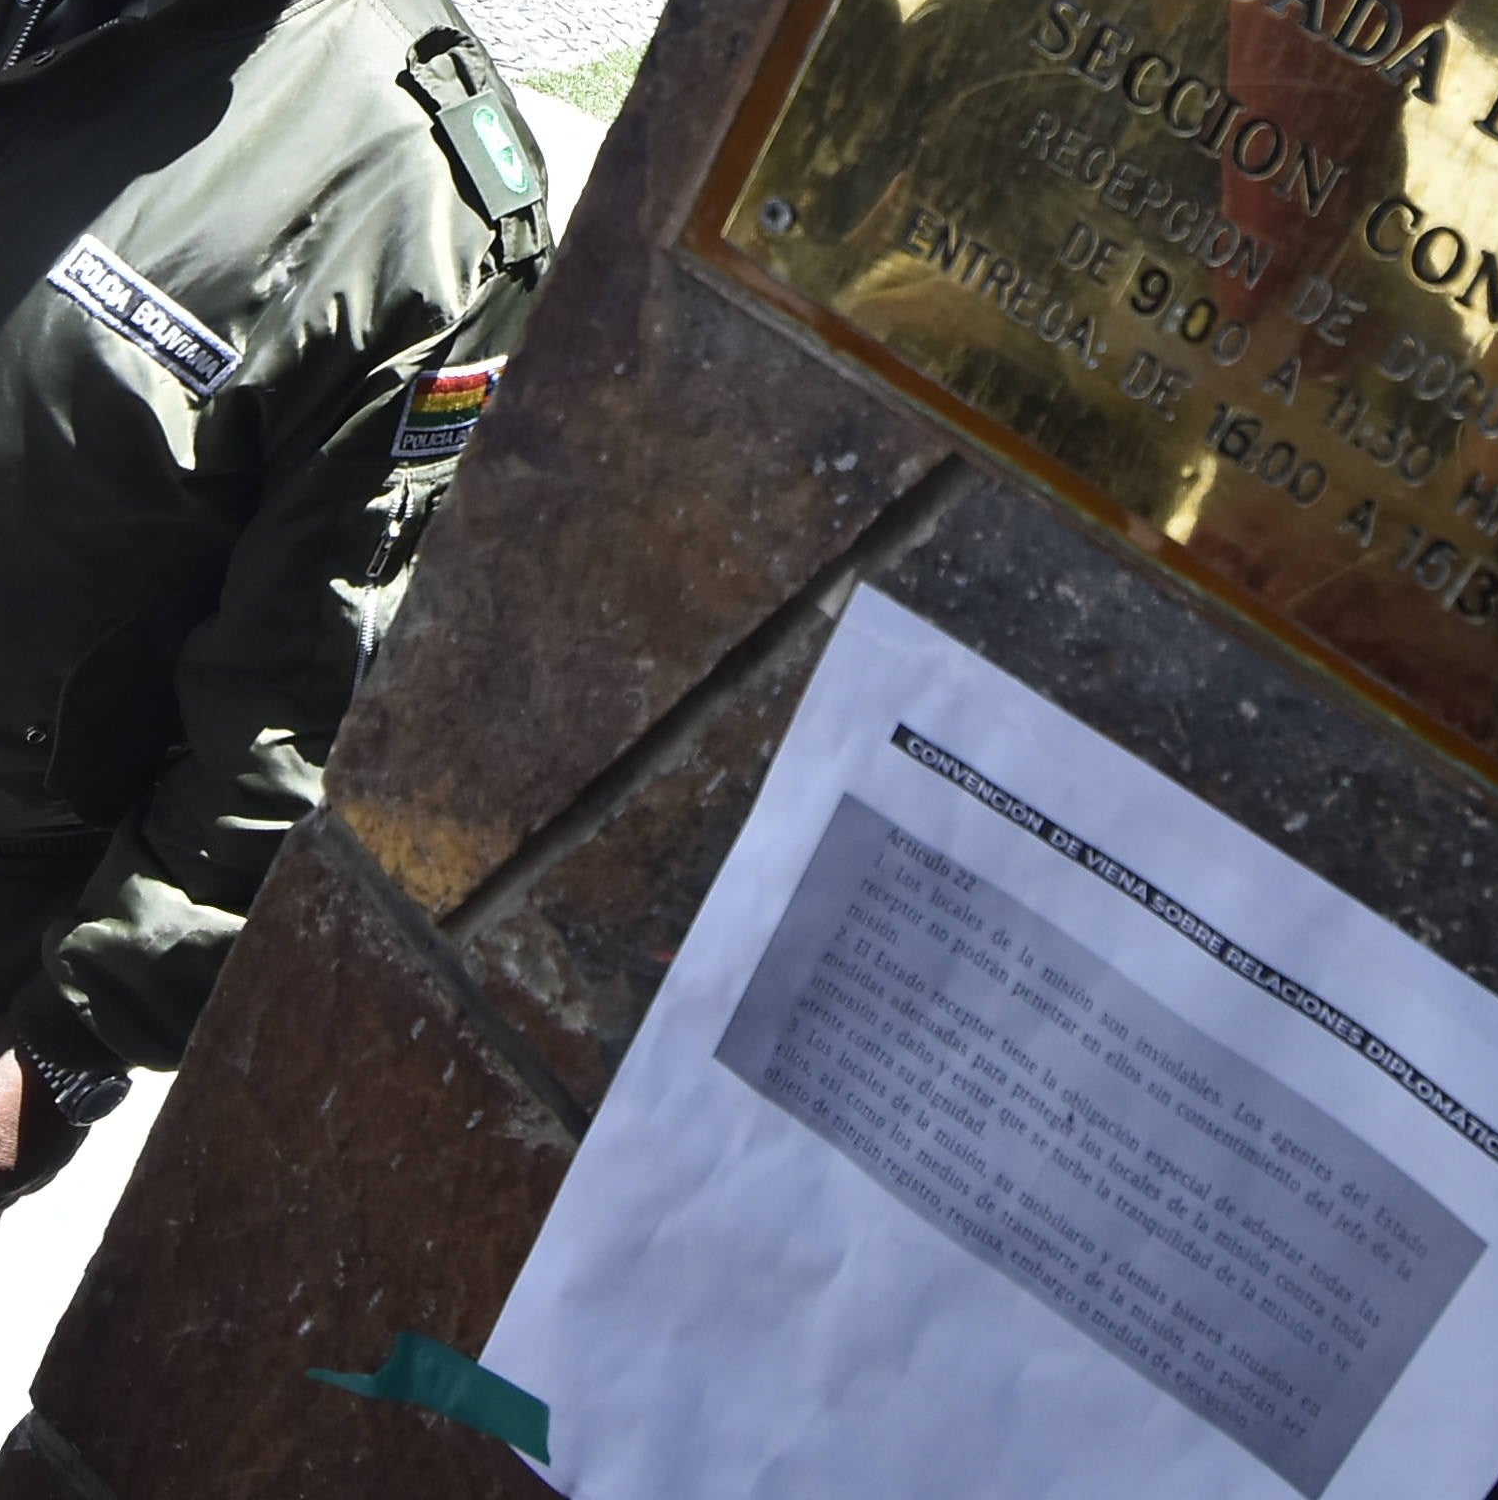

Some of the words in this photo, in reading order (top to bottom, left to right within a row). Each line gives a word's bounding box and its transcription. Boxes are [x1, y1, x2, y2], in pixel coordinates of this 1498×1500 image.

[1020, 109, 1274, 290] RECEPCION
[1290, 274, 1368, 347] DE
[1058, 222, 1129, 285] DE
[1130, 266, 1251, 367] 9:00
[1262, 356, 1302, 406] A
[1120, 349, 1193, 422] DE
[1338, 499, 1378, 548] A
[903, 735, 1046, 833] CONVENCIÓN
[1046, 827, 1083, 858] DE
[1079, 848, 1152, 902] VIENA
[1148, 893, 1225, 955] SOBRE
[1221, 946, 1366, 1047] RELACIONES
